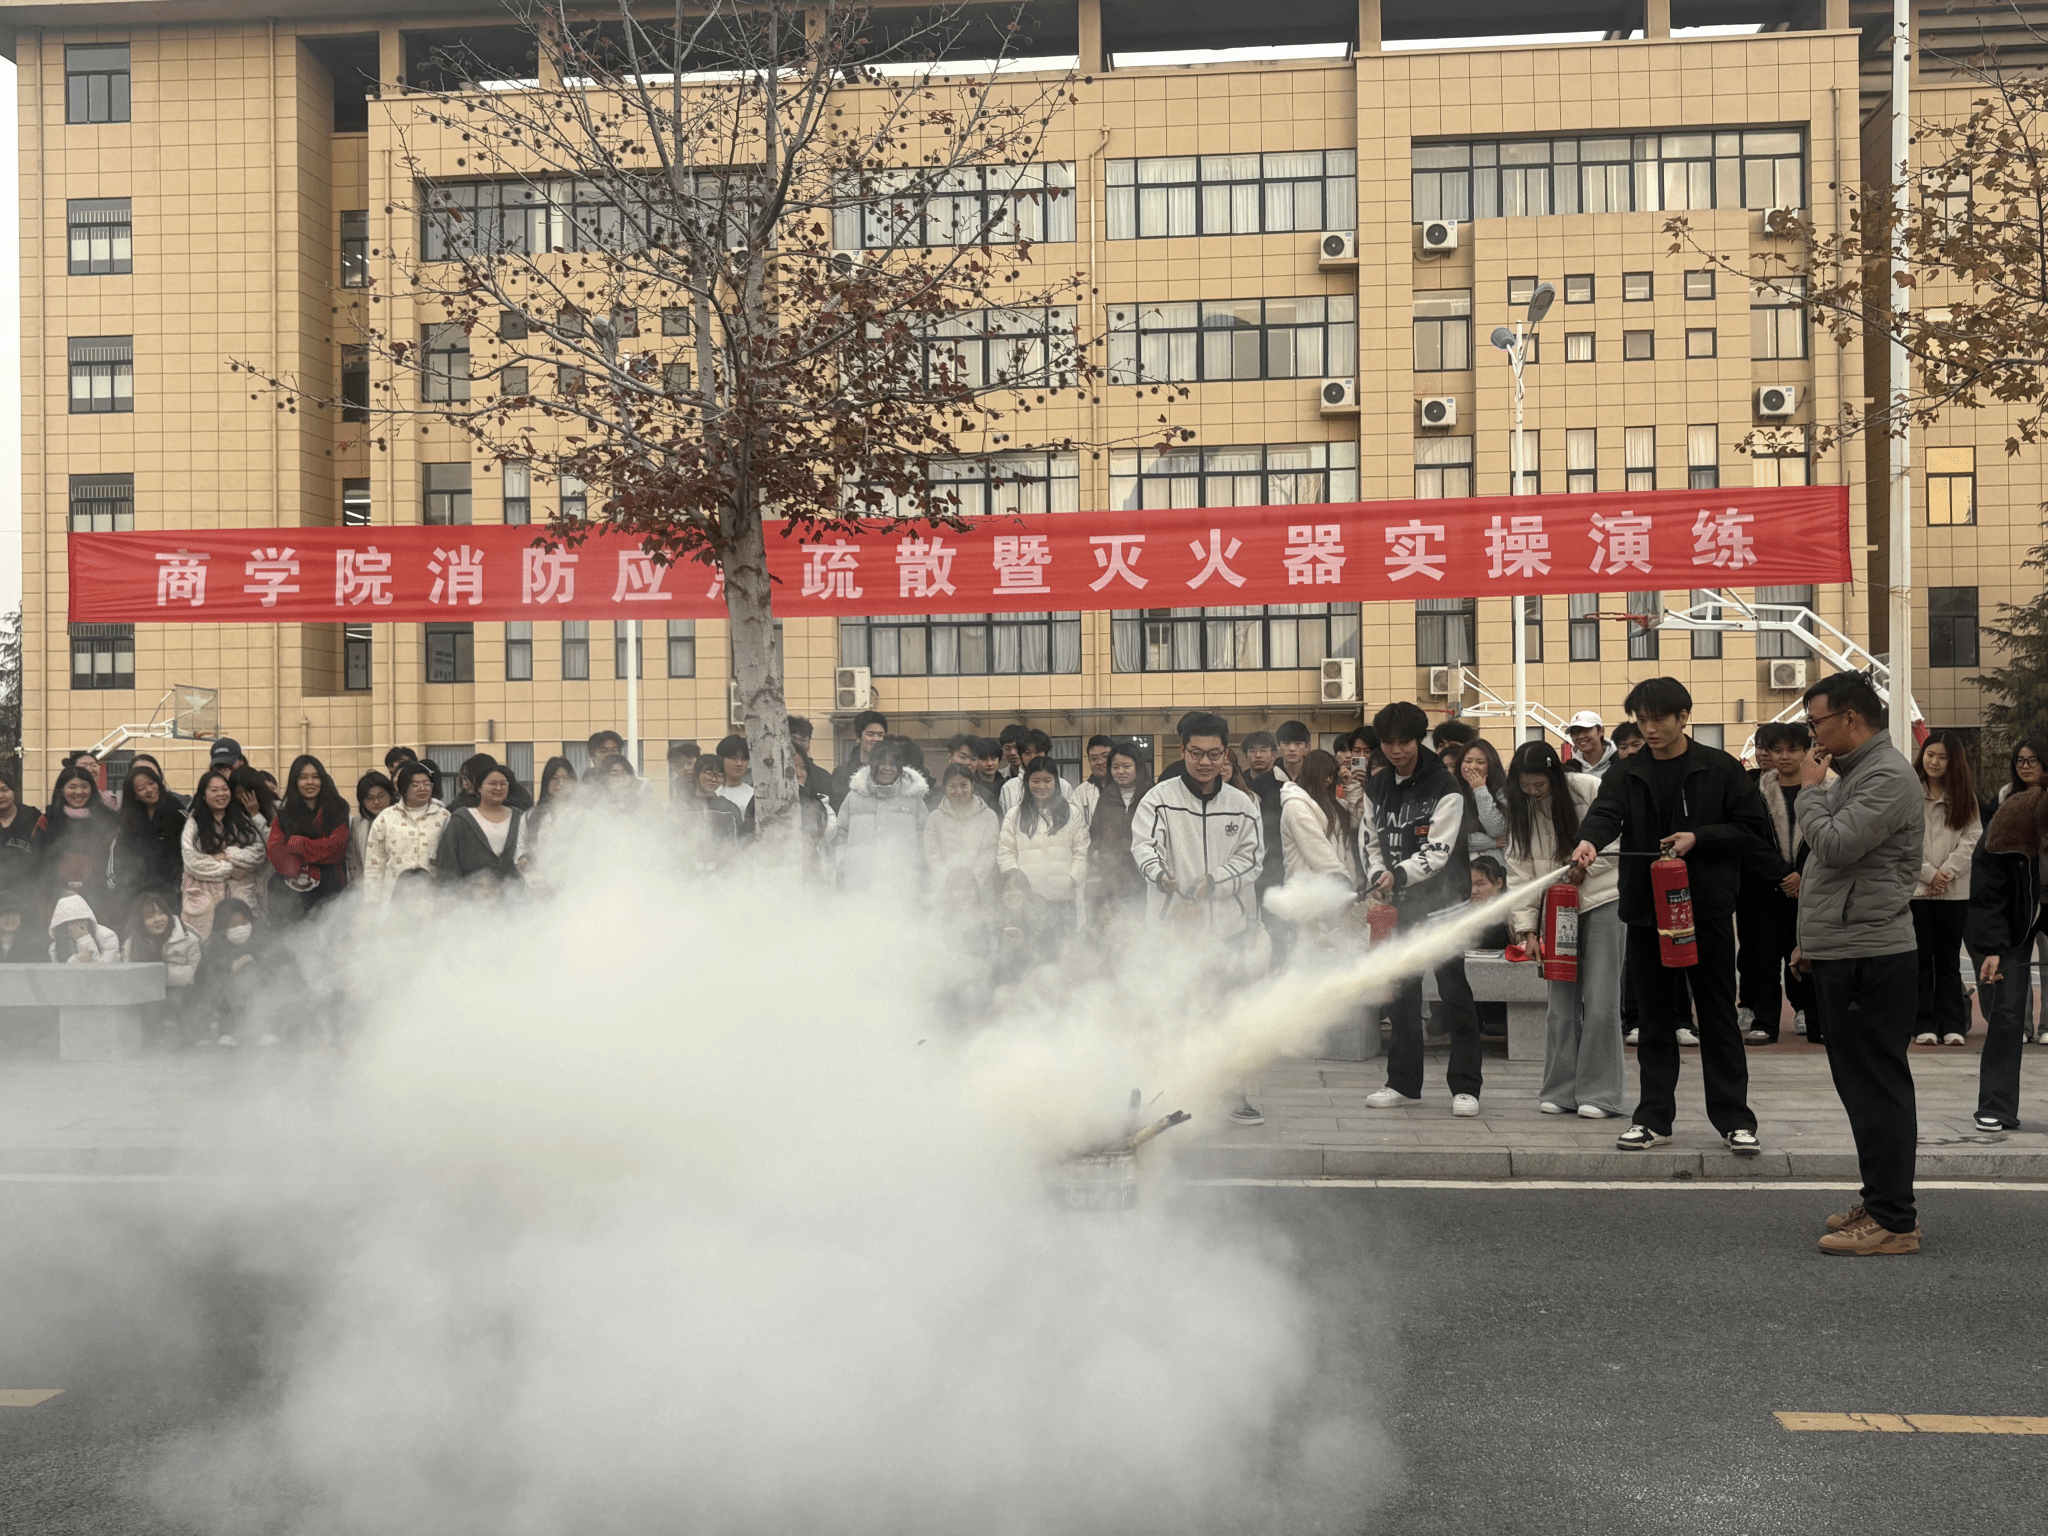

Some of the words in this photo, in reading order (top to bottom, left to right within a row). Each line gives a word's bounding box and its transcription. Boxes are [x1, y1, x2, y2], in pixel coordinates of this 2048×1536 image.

[155, 507, 1757, 608] 商学院消防应疏散暨灭火器实操演练
